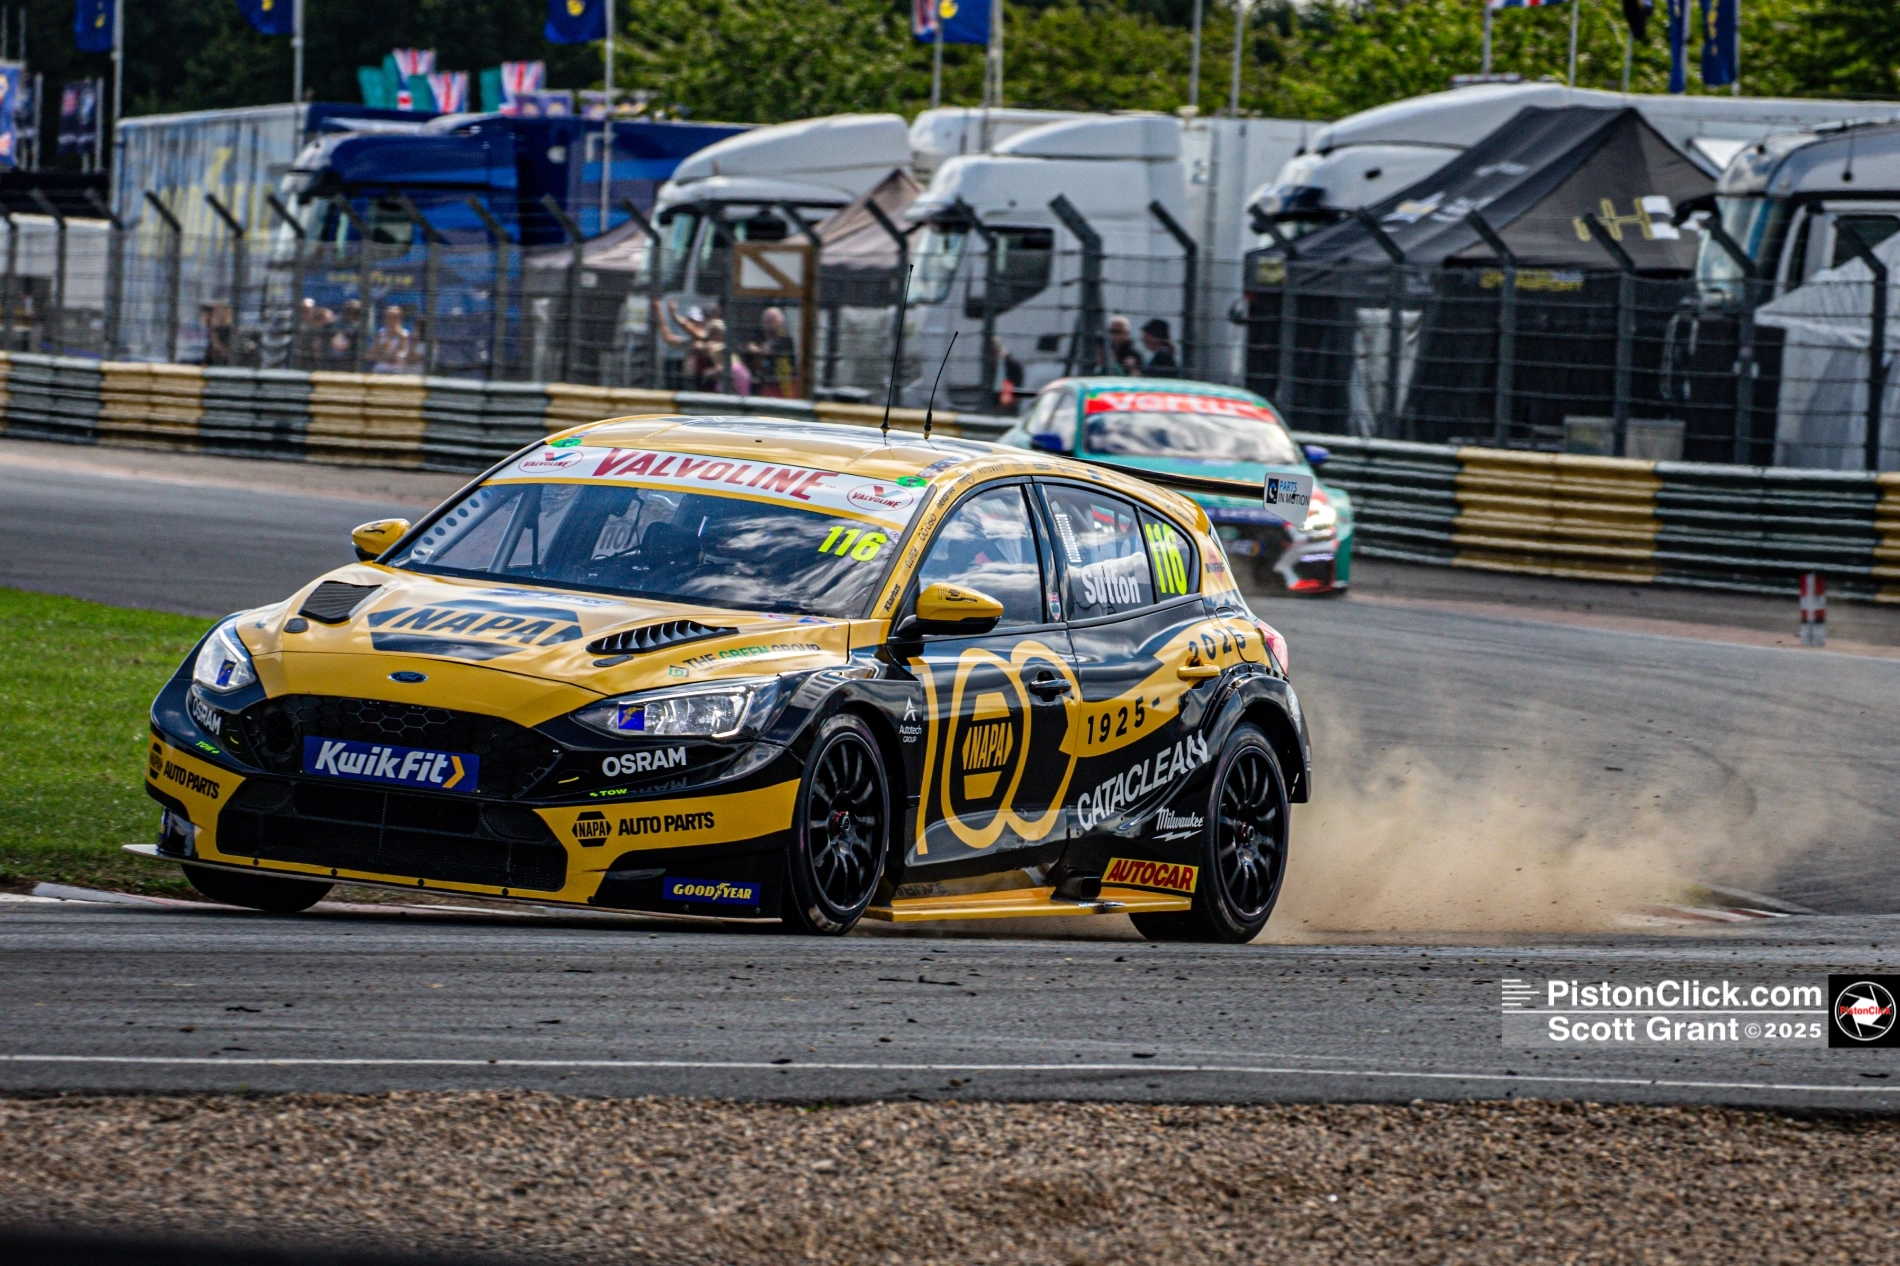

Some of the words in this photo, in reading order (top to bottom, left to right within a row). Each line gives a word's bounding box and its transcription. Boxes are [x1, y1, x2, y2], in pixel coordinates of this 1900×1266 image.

[592, 448, 839, 501] VALVOLINE
[1279, 480, 1297, 492] PARTS
[852, 492, 902, 508] VALVOLINE
[1278, 492, 1285, 503] IN
[1285, 493, 1310, 506] MOTION
[818, 525, 887, 562] 116
[1145, 523, 1188, 595] 116
[1204, 562, 1225, 573] NRF
[1081, 566, 1141, 604] Sutton
[390, 607, 555, 644] NAPA
[682, 653, 718, 669] THE
[718, 645, 769, 661] GREEN
[192, 697, 222, 735] OSRAM
[899, 725, 922, 735] Autotech
[602, 746, 687, 777] OSRAM
[968, 722, 1004, 770] NAPA
[163, 760, 187, 785] AUTO
[185, 771, 220, 799] PARTS
[599, 788, 628, 797] TOW
[1077, 729, 1209, 831] CATACLEAN
[579, 821, 606, 838] NAPA
[618, 815, 661, 836] AUTO
[664, 811, 715, 832] PARTS
[1155, 806, 1204, 831] Milwaukee
[1106, 859, 1195, 891] AUTOCAR
